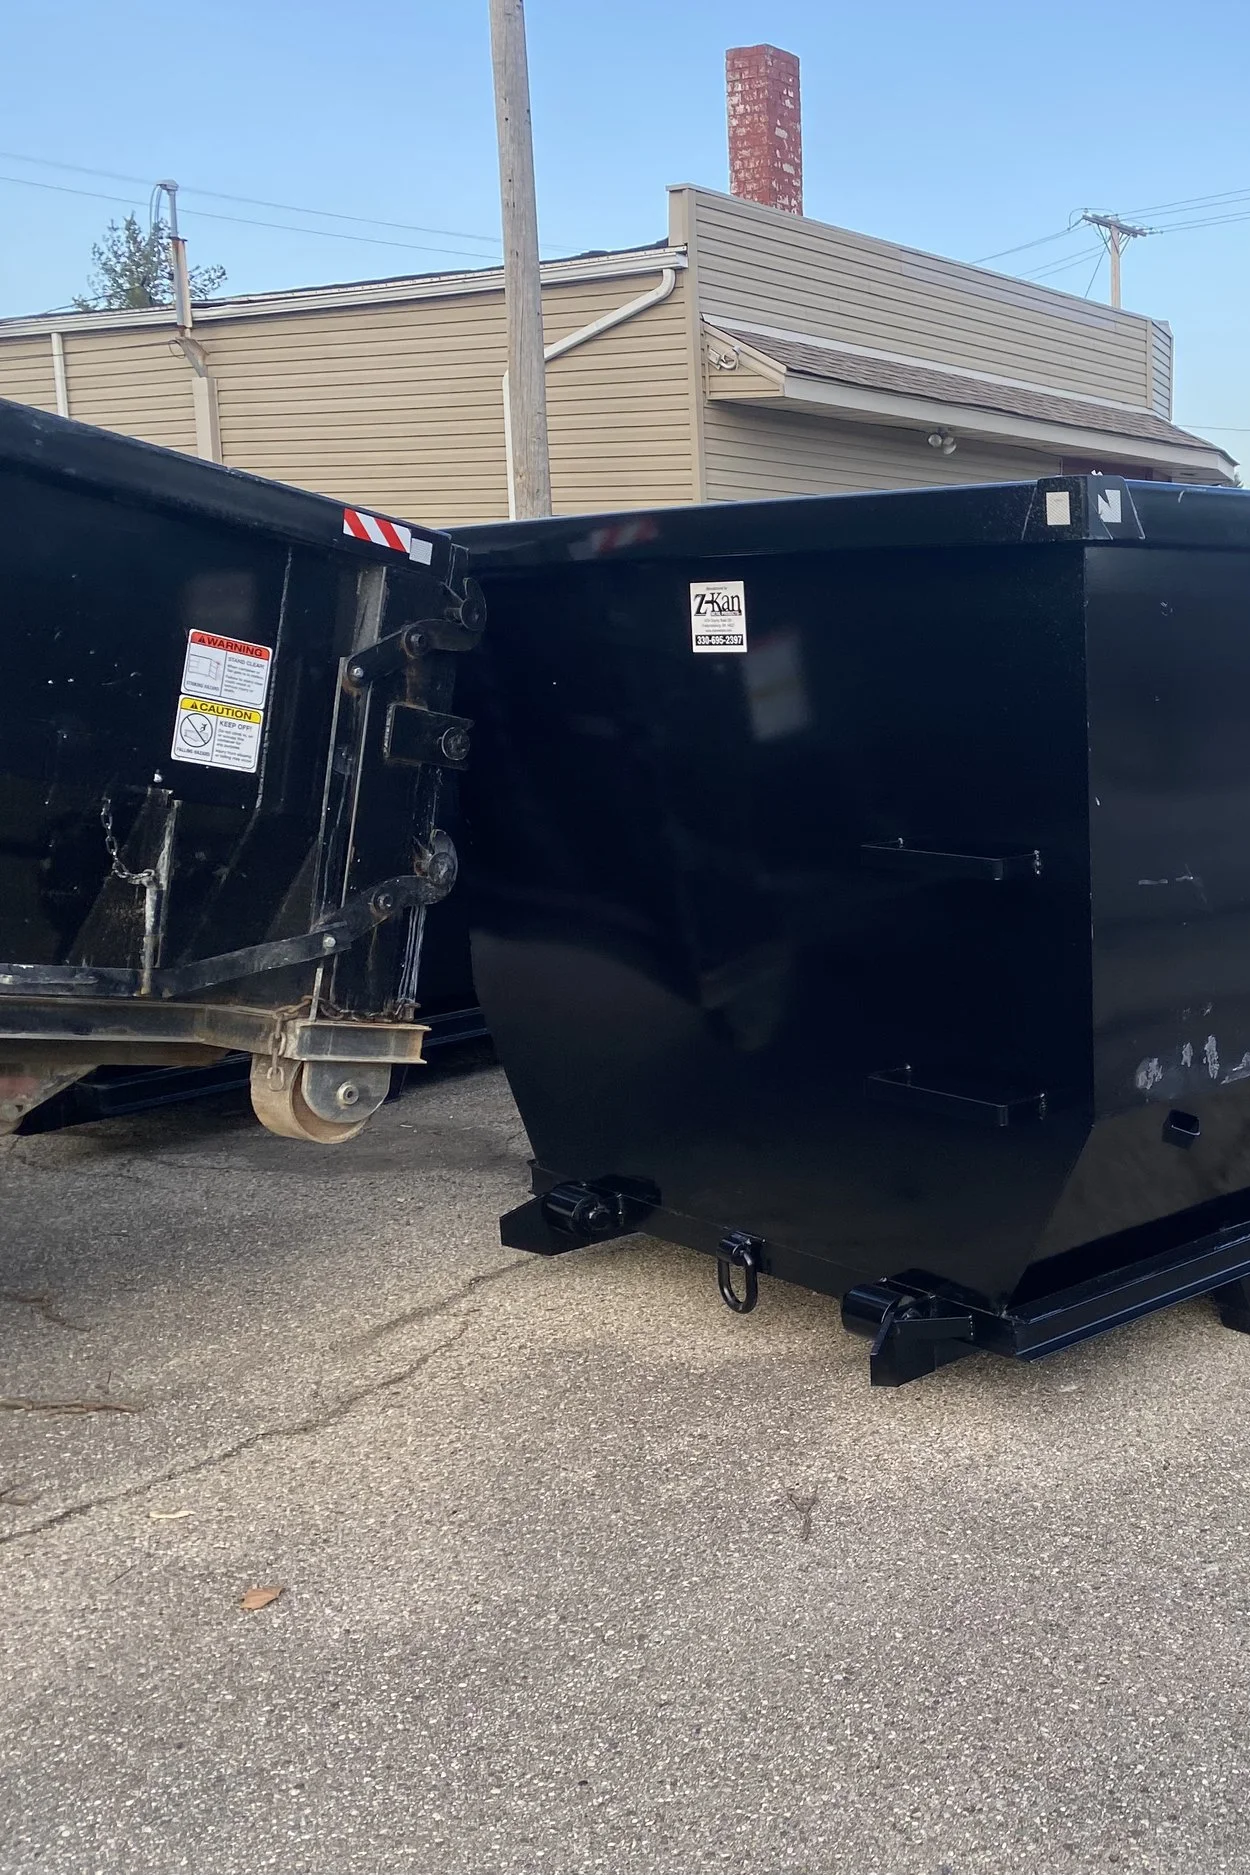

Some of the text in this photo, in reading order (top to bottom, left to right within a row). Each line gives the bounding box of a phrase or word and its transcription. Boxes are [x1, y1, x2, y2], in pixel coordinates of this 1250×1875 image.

[694, 592, 742, 616] Z-Kan
[207, 637, 263, 657] WARNING
[697, 635, 742, 645] 330-695-2397
[200, 703, 253, 721] CAUTION
